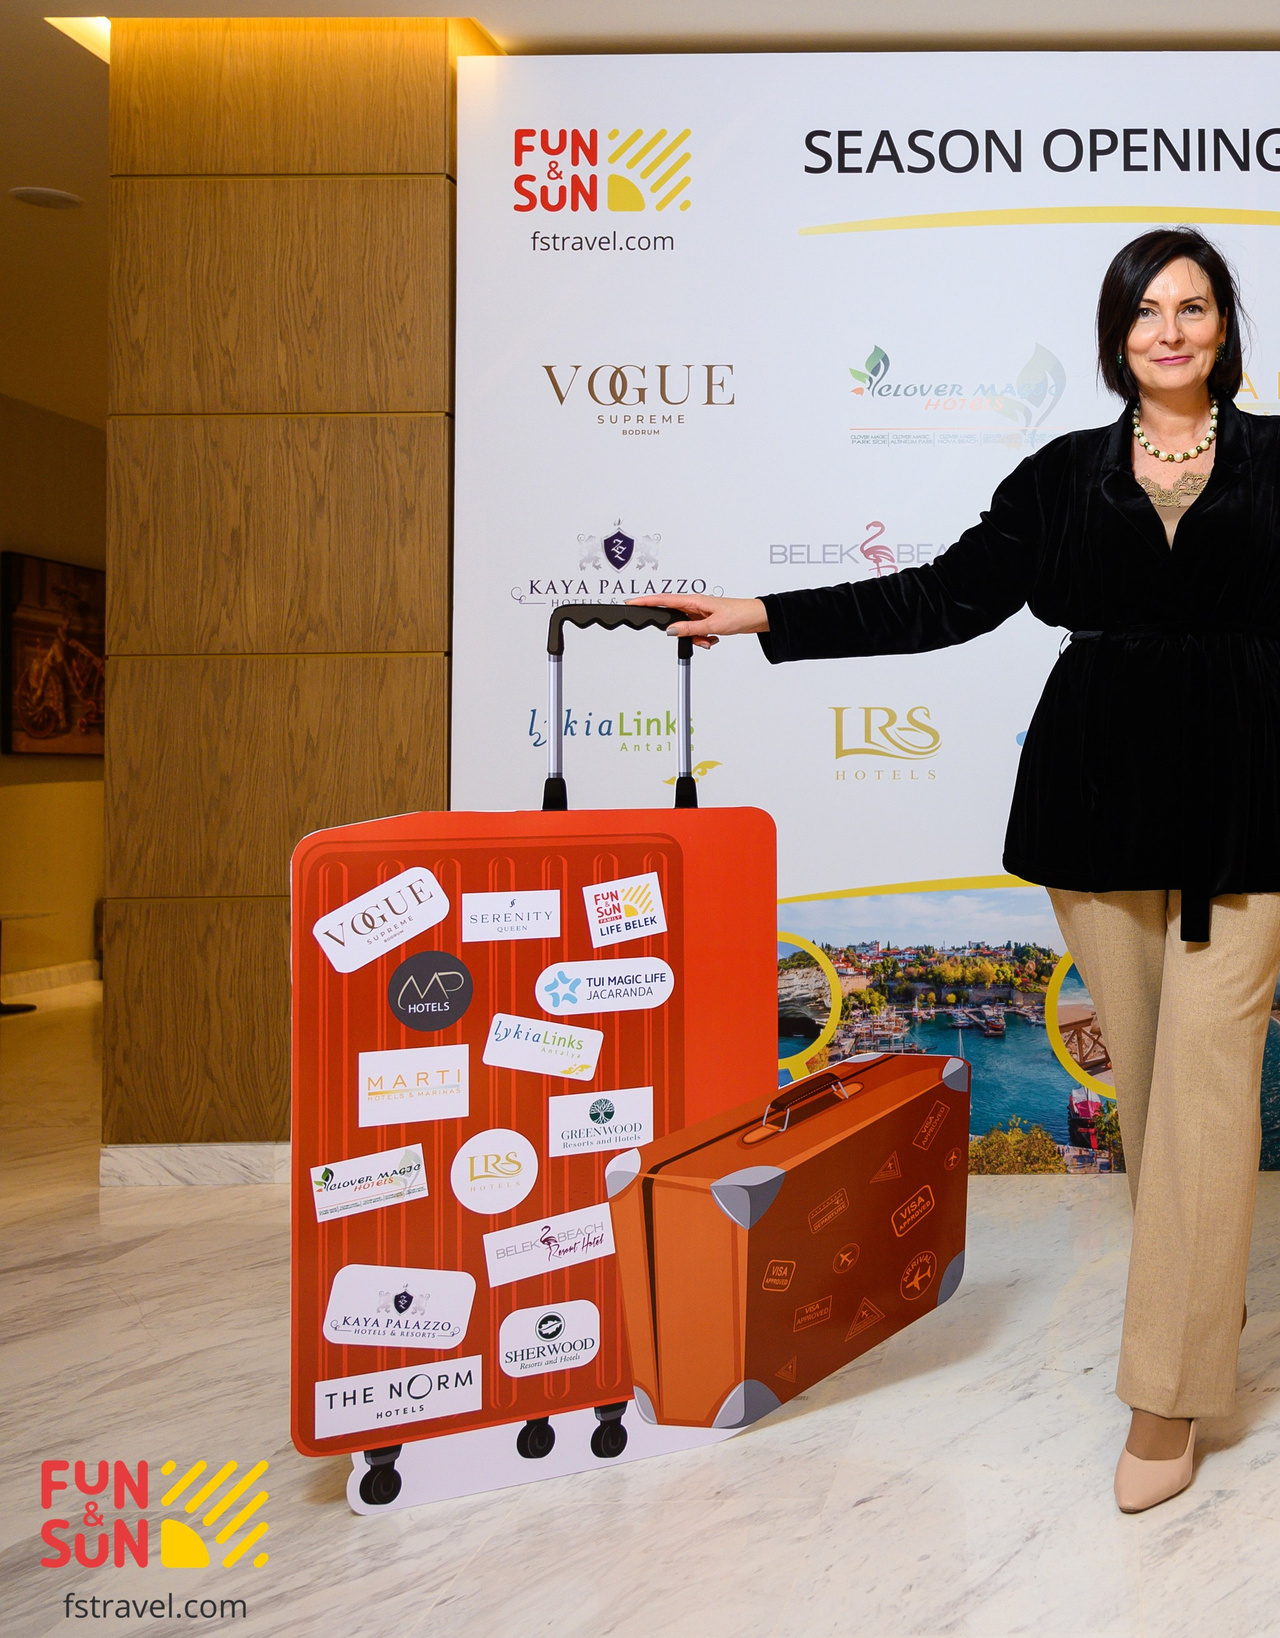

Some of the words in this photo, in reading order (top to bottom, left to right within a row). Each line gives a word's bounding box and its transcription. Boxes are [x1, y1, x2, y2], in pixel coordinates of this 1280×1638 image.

[514, 128, 598, 167] FUN
[804, 128, 1022, 175] SEASON
[547, 160, 563, 180] &
[513, 174, 598, 212] SUN
[531, 231, 674, 251] fstravel.com
[541, 364, 735, 406] VOGUE
[597, 415, 685, 425] SUPREME
[770, 544, 860, 564] BELEK
[529, 579, 590, 595] KAYA
[600, 578, 707, 594] PALAZZO
[828, 706, 942, 760] LRS
[620, 742, 694, 751] Antala
[835, 770, 936, 780] HOTELS
[594, 890, 619, 905] FUN
[323, 878, 433, 947] VOGUE
[470, 911, 553, 924] SERENITY
[596, 903, 621, 918] SUN
[366, 916, 413, 945] SUPREME
[497, 925, 528, 933] QUEEN
[600, 923, 622, 937] LIFE
[624, 916, 657, 931] BELEK
[586, 978, 605, 987] TUI
[608, 975, 642, 986] MAGIC
[645, 973, 666, 983] LIFE
[587, 987, 653, 1000] JACARANDA
[408, 1002, 450, 1013] HOTELS
[541, 1047, 581, 1058] Antalya
[368, 1069, 461, 1091] MARTI
[368, 1093, 404, 1102] HOTELS
[417, 1088, 460, 1097] MARINAS
[561, 1122, 642, 1140] GREENWOOD
[921, 1116, 934, 1133] VISA
[563, 1141, 594, 1149] Resorts
[615, 1134, 641, 1142] Hotels
[467, 1151, 523, 1182] LRS
[470, 1181, 521, 1192] HOTELS
[899, 1200, 931, 1232] APPROVED
[900, 1196, 925, 1219] VISA
[813, 1204, 847, 1231] DEPARTURE
[496, 1238, 540, 1259] BELEK
[557, 1222, 604, 1242] BEACH
[582, 1233, 605, 1254] Hotel
[771, 1266, 787, 1276] VISA
[902, 1254, 931, 1283] ARRIVAL
[765, 1278, 788, 1286] APPROVED
[796, 1308, 829, 1325] APPROVED
[804, 1303, 820, 1314] VISA
[342, 1316, 379, 1327] KAYA
[386, 1319, 451, 1331] PALAZZO
[505, 1338, 594, 1364] SHERWOOD
[520, 1362, 542, 1370] Resorts
[545, 1357, 557, 1365] and
[560, 1353, 580, 1363] Hotels
[325, 1387, 374, 1409] THE
[389, 1370, 473, 1399] NORM
[376, 1405, 425, 1420] HOTELS
